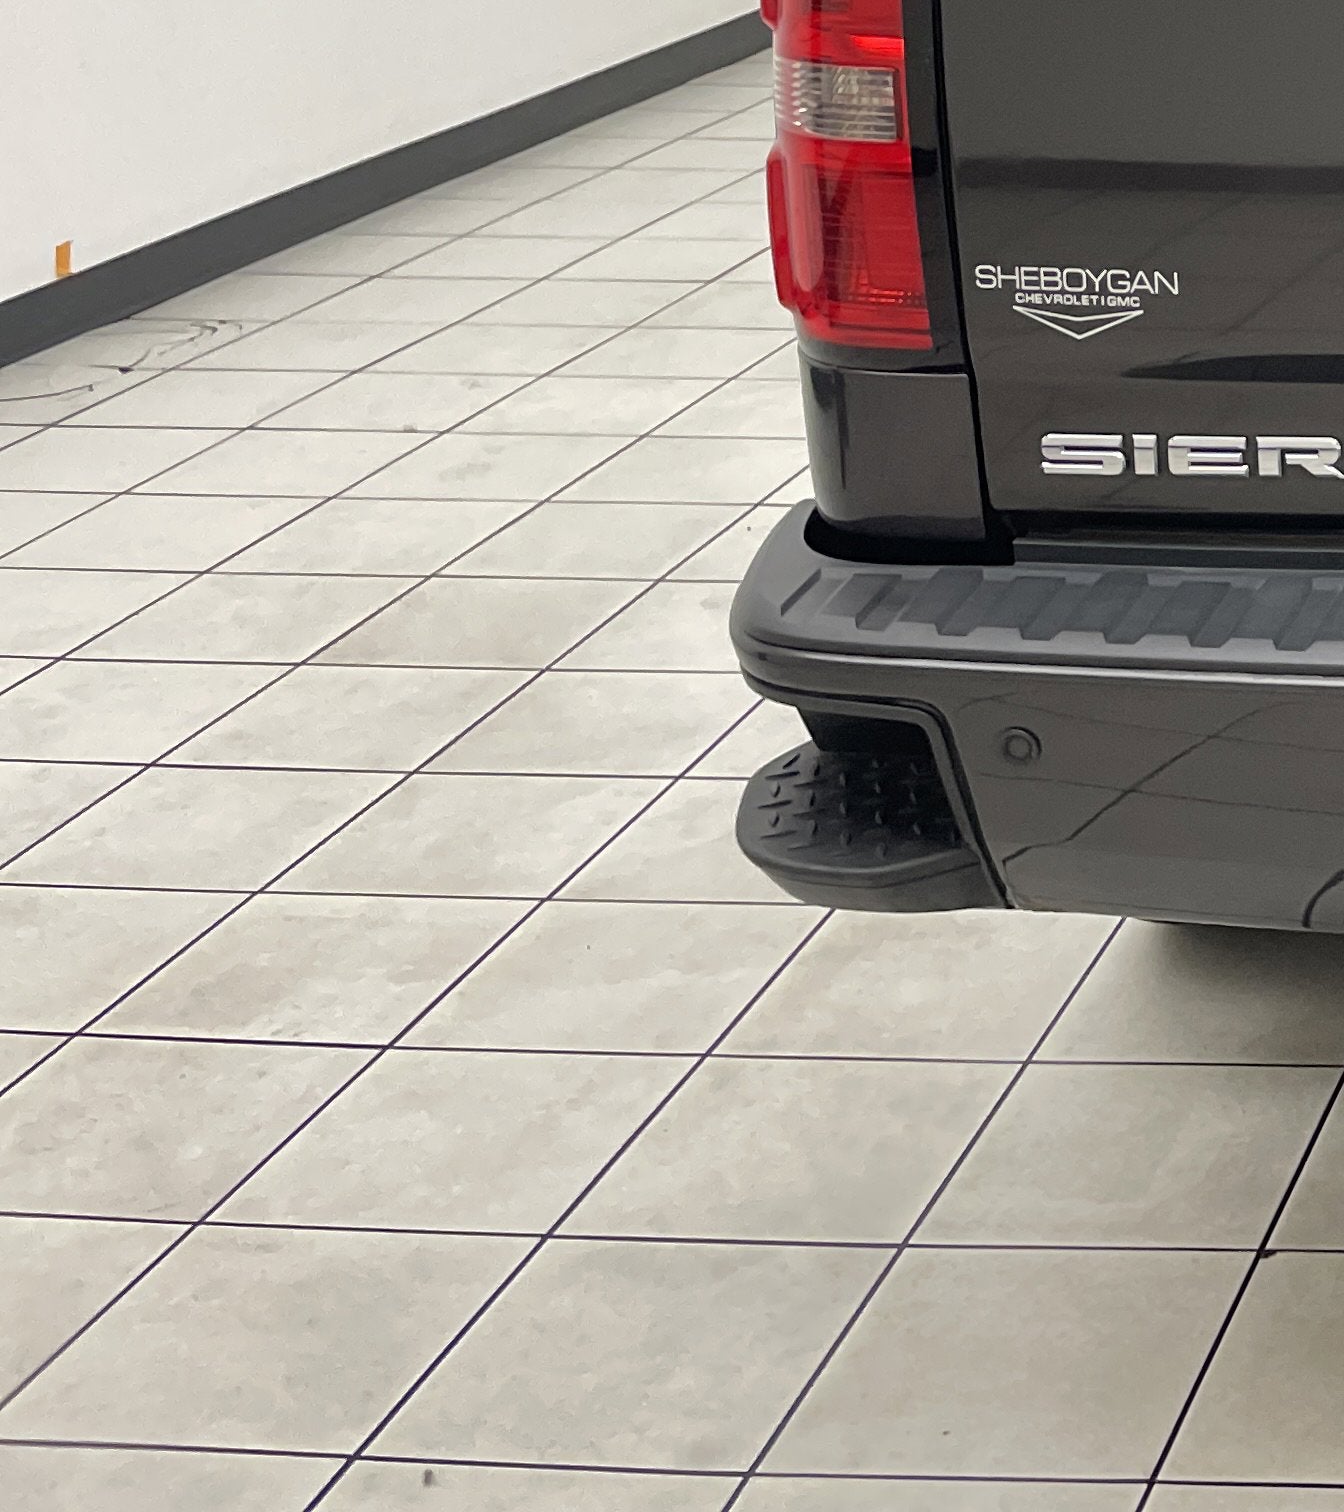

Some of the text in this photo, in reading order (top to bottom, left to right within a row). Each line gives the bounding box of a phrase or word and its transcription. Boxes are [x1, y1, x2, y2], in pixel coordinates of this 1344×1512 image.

[975, 265, 1179, 295] SHEBOYGAN
[1015, 292, 1141, 308] CHEVROLET GMC
